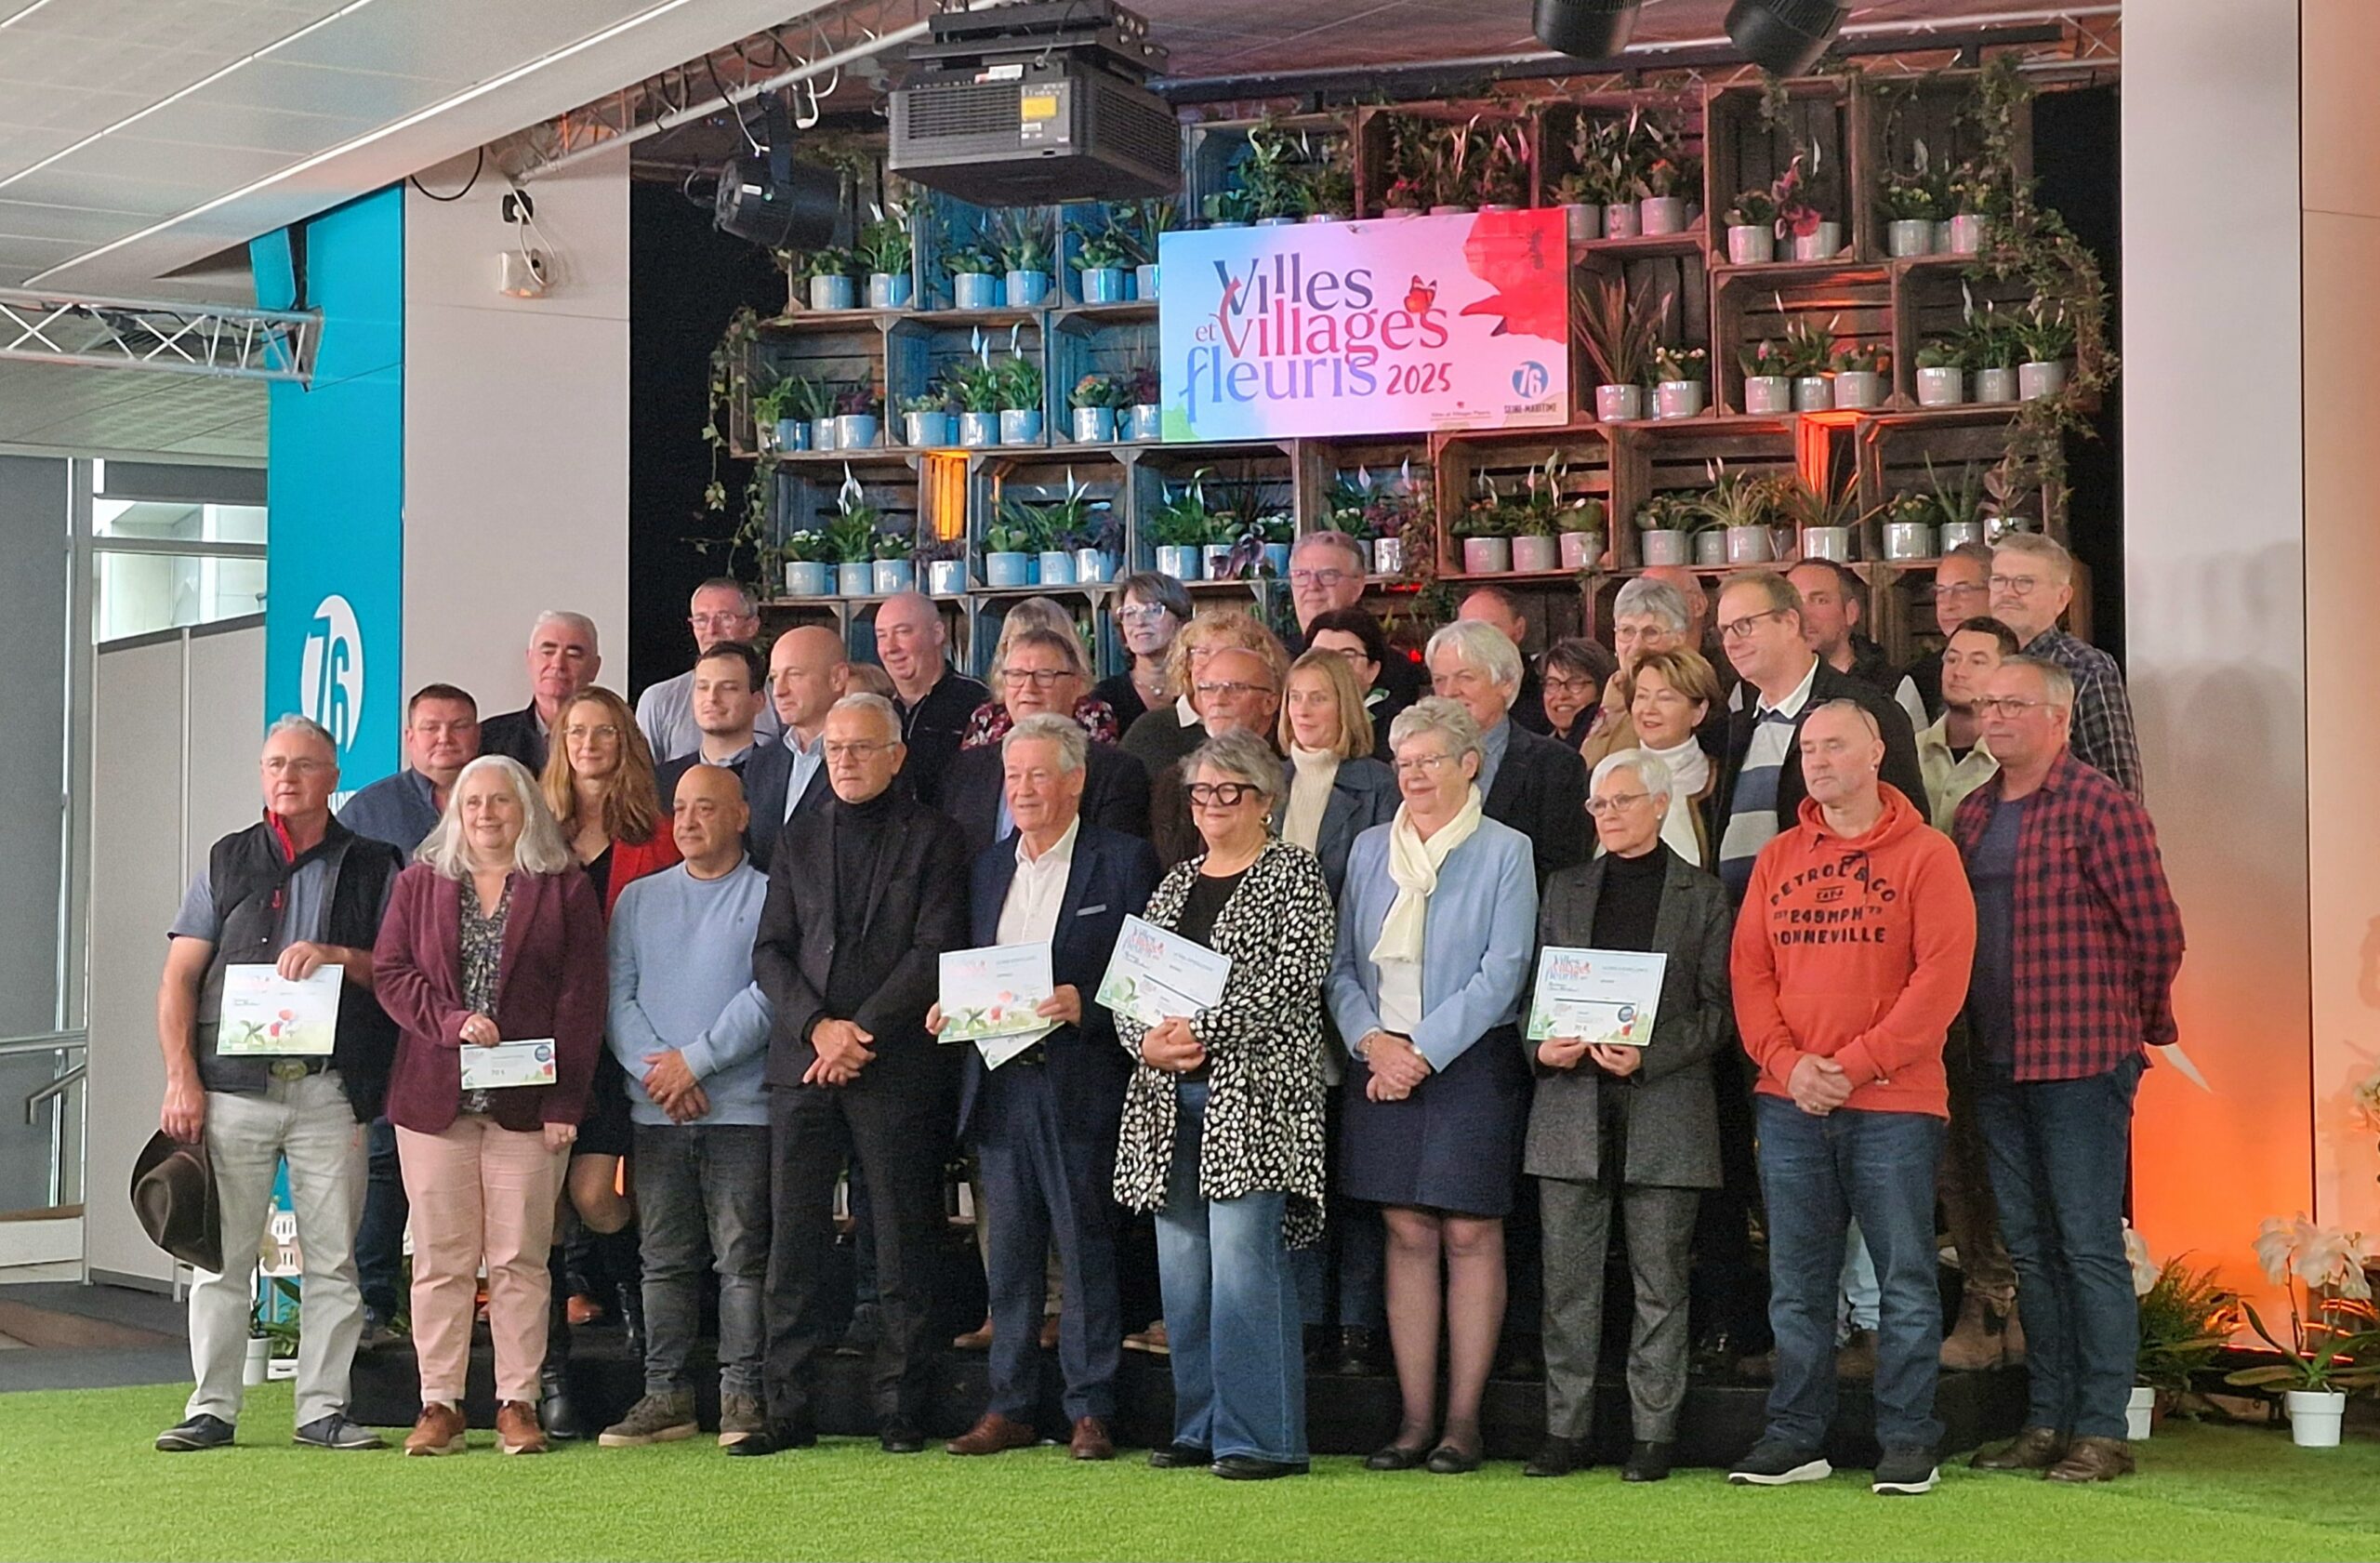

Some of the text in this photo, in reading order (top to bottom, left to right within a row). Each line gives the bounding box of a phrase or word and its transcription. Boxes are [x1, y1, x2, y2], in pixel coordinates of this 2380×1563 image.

[1195, 276, 1448, 367] et Villages
[1213, 252, 1373, 316] Villes
[1178, 345, 1453, 424] fleuris 2025
